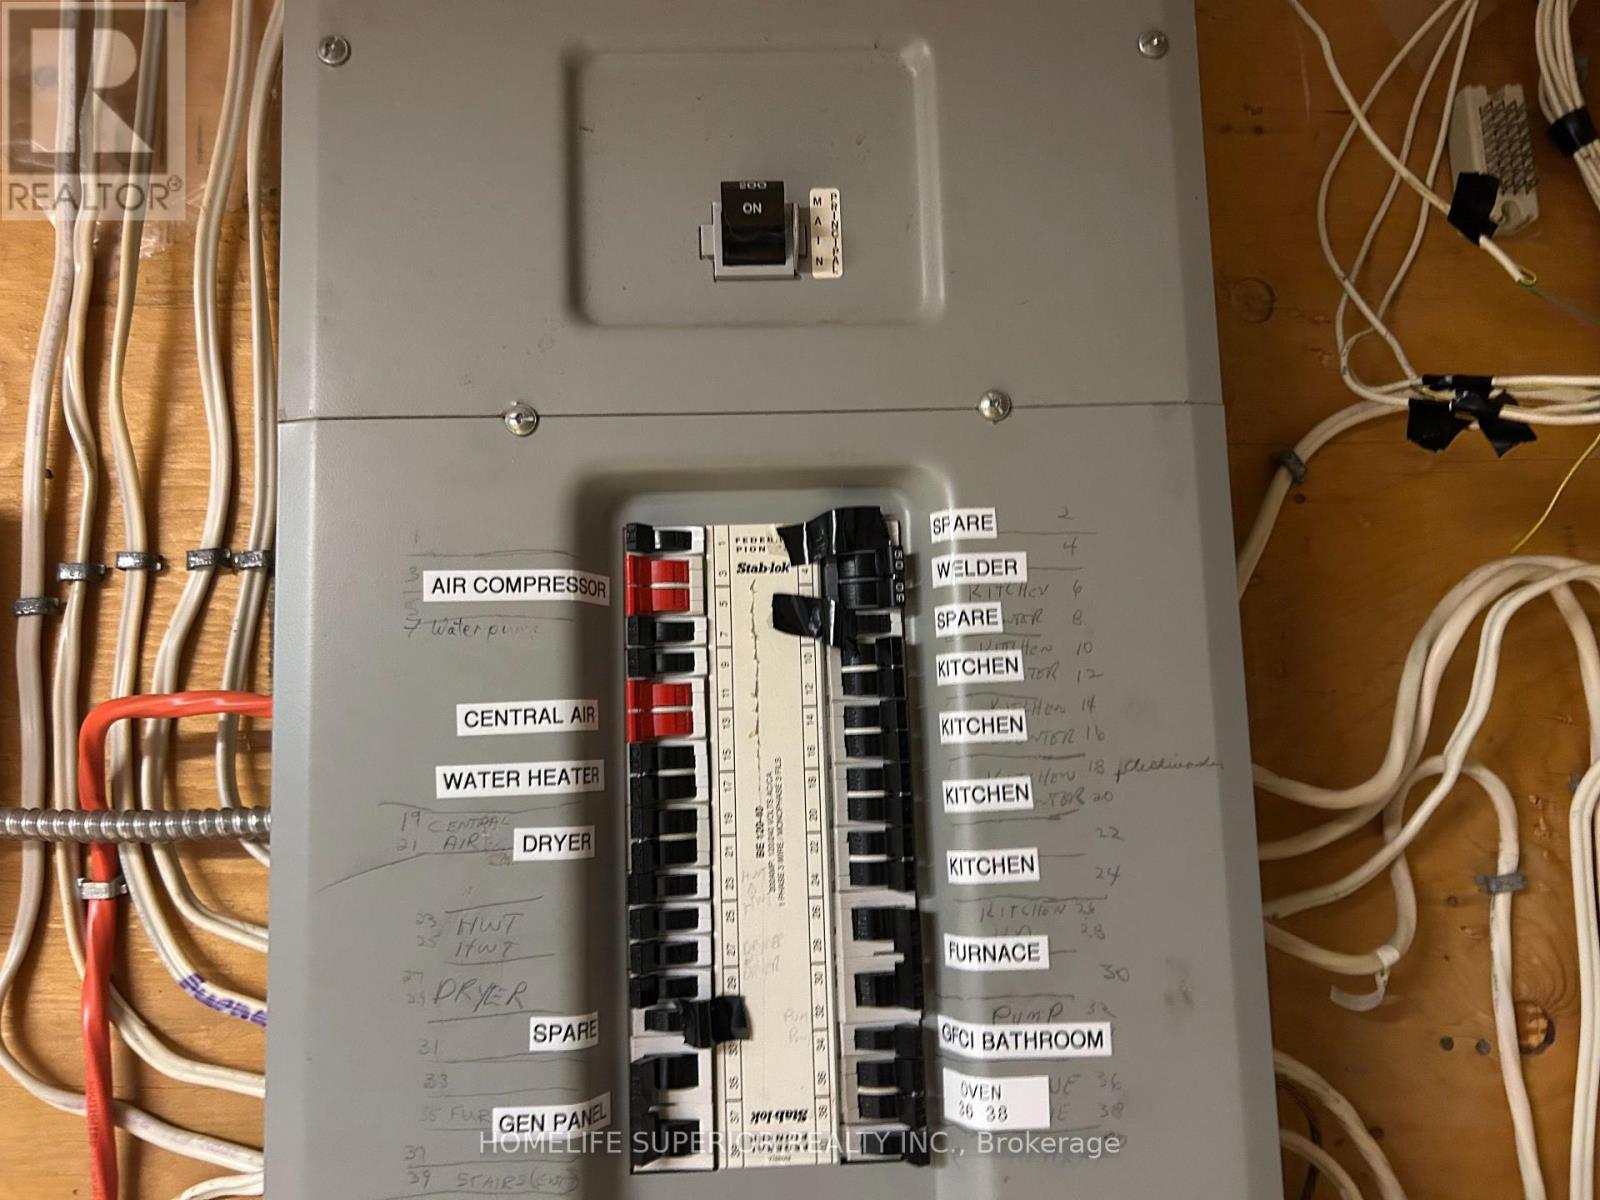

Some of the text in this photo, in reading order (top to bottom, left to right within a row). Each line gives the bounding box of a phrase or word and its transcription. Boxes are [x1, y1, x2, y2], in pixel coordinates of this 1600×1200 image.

[742, 202, 762, 215] ON
[813, 197, 823, 266] MAIN
[933, 514, 993, 535] SPARE
[1063, 536, 1078, 556] 4
[937, 558, 1018, 579] WELDER
[432, 576, 607, 598] AIR COMPRESSOR
[432, 617, 480, 636] Water
[937, 608, 998, 629] SPARE
[1077, 642, 1092, 657] 10
[938, 656, 1019, 678] KITCHEN
[1077, 669, 1104, 684] 12
[464, 706, 595, 728] CENTRAL AIR
[942, 715, 1024, 736] KITCHEN
[1086, 725, 1105, 741] 16
[1089, 759, 1105, 774] 18
[444, 766, 600, 790] WATER HEATER
[946, 783, 1030, 804] KITCHEN
[401, 810, 420, 832] 19
[444, 834, 480, 850] AIR
[523, 832, 592, 853] DRYER
[1095, 826, 1123, 840] 22
[949, 855, 1035, 877] KITCHEN
[1095, 864, 1121, 886] 24
[457, 912, 524, 936] HWT
[455, 940, 520, 958] HWT
[949, 942, 1041, 962] FURNACE
[1101, 963, 1130, 982] 30
[433, 978, 528, 1012] DRYER
[533, 1020, 597, 1042] SPARE
[942, 1023, 1104, 1050] GFCI BATHROOM
[960, 1080, 1002, 1101] OVEN
[499, 1102, 607, 1133] GEN PANEL
